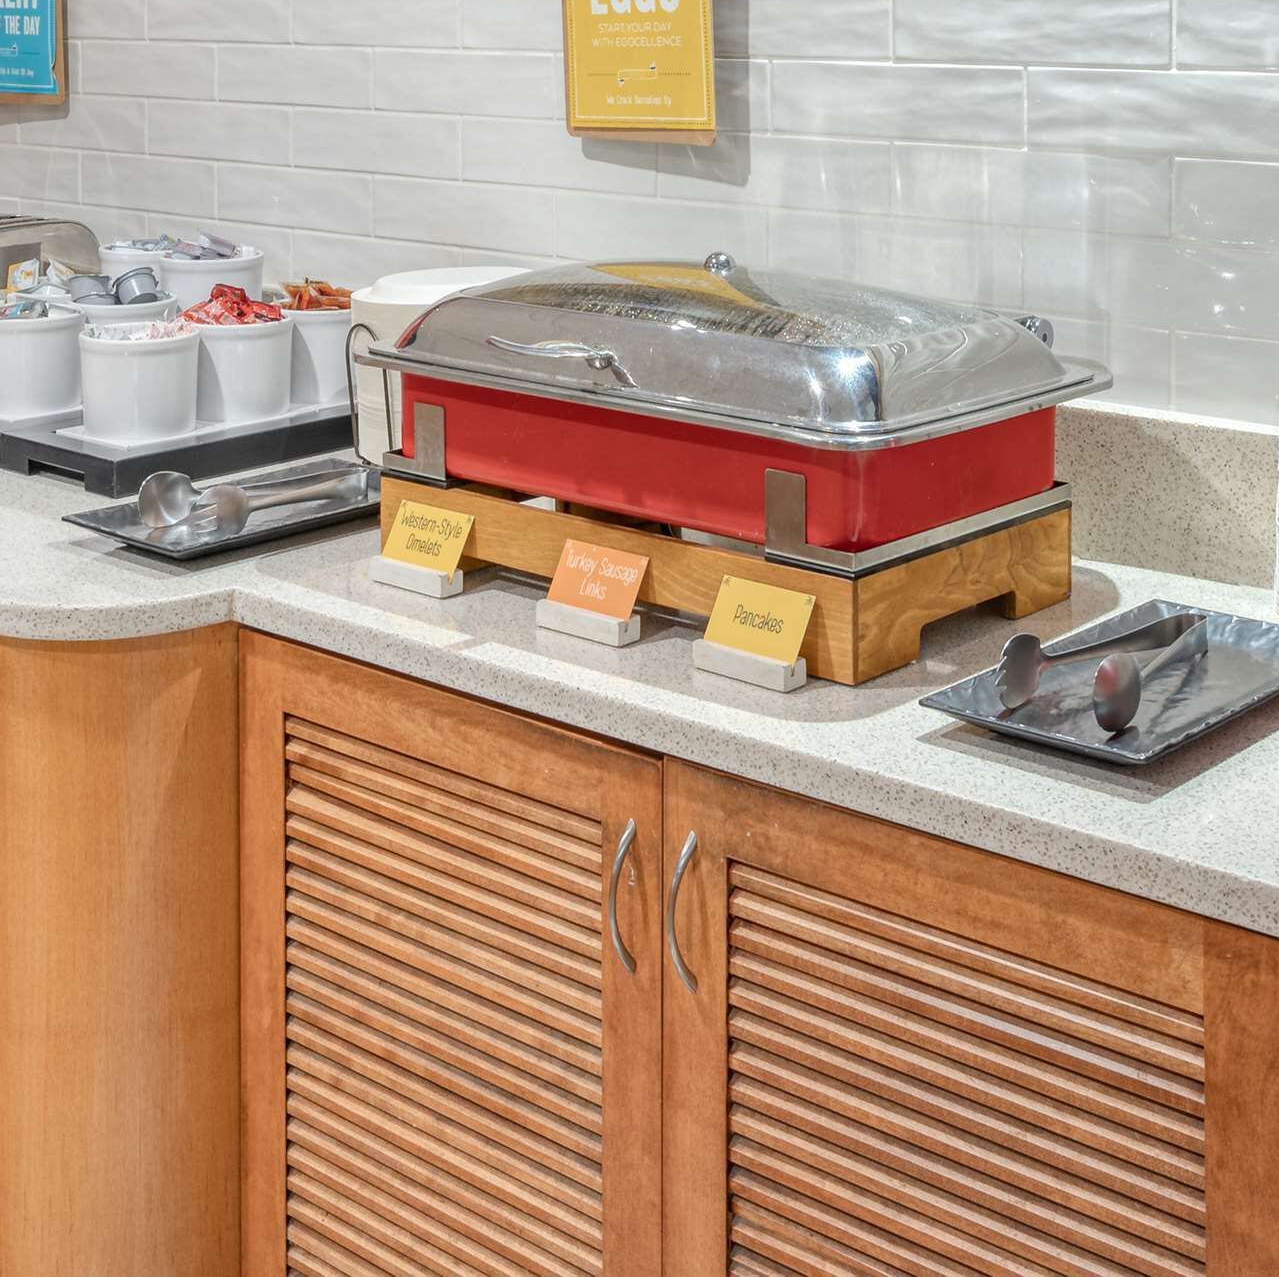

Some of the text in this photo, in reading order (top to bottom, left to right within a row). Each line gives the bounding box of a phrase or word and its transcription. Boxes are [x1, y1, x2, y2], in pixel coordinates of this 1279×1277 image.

[4, 15, 21, 35] THE
[23, 16, 41, 36] DAY
[400, 510, 463, 540] Western-Style
[406, 534, 442, 558] Omelets
[565, 550, 638, 586] Turkey Sausage
[580, 577, 607, 601] Links
[732, 603, 785, 635] Pancakes
